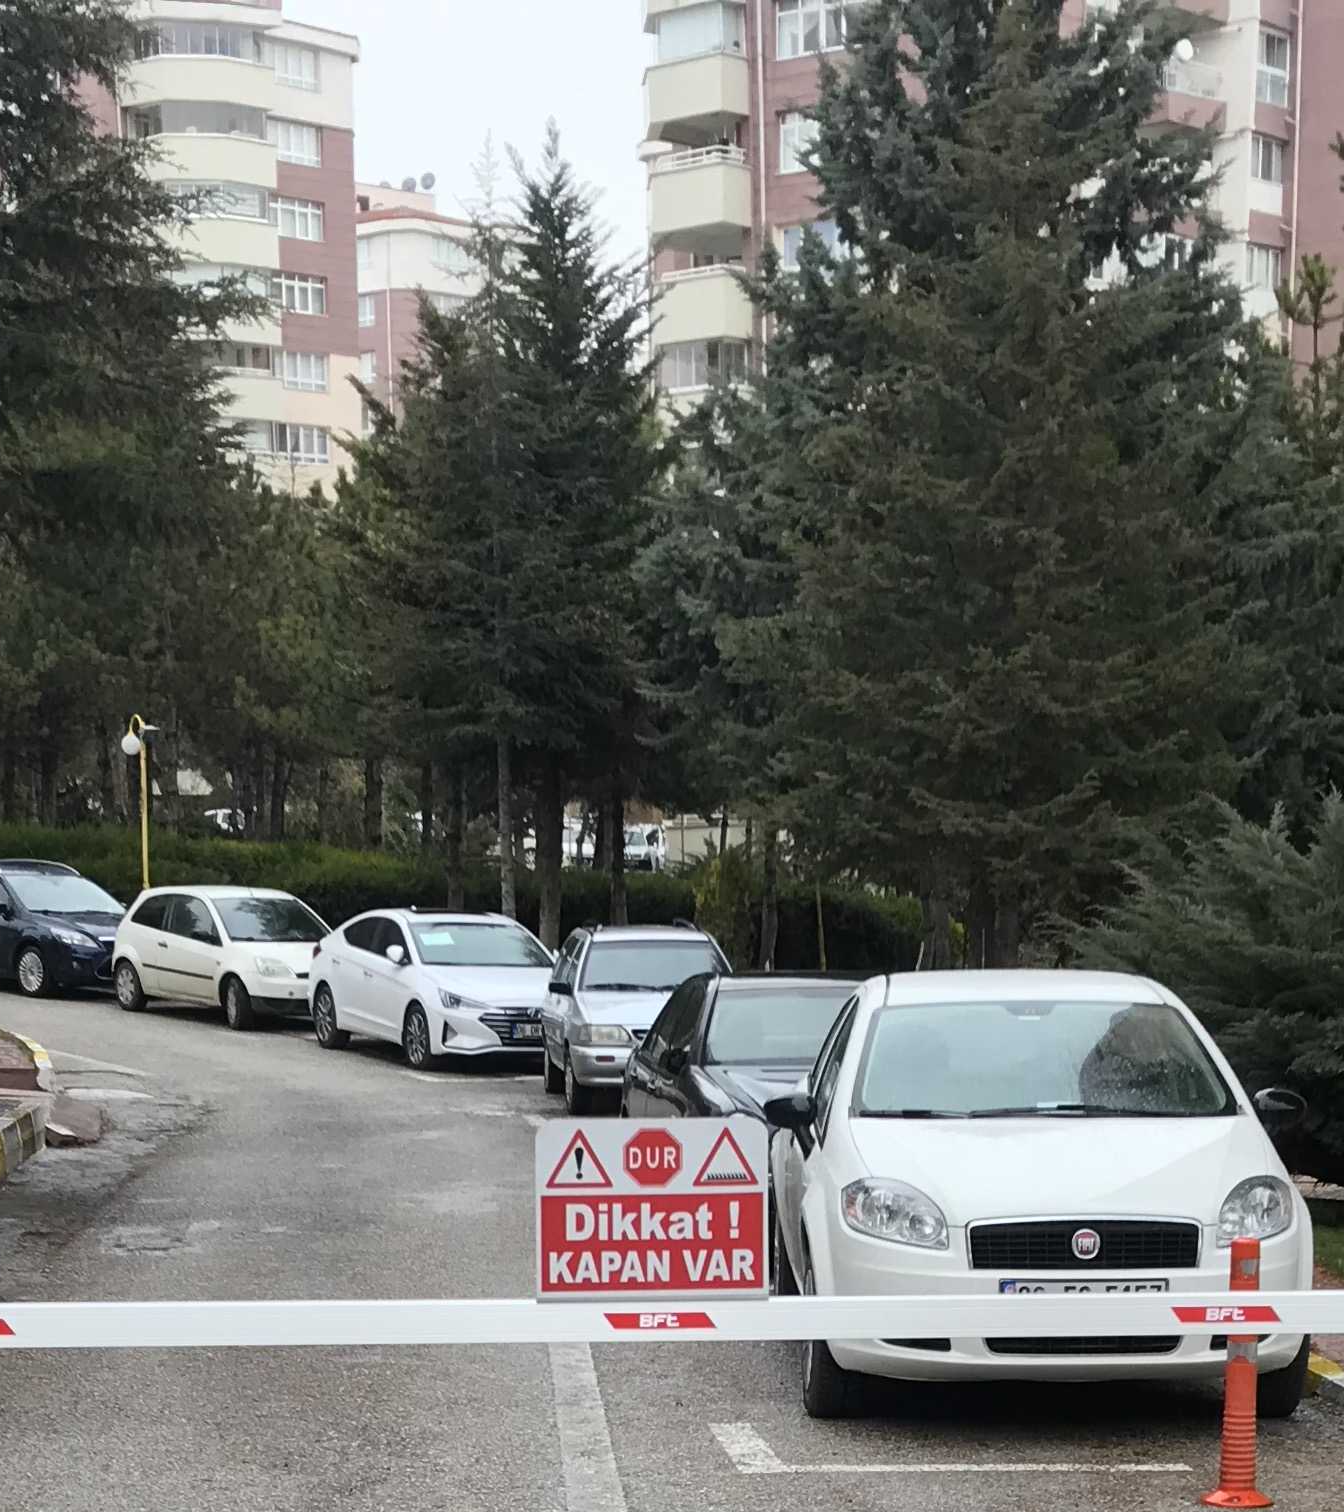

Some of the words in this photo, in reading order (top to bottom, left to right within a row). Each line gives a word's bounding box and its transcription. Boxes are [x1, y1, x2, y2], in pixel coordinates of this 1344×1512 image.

[629, 1146, 677, 1169] DUR
[565, 1202, 713, 1241] Dikkat
[729, 1201, 740, 1240] !
[549, 1250, 671, 1284] KAPAN
[682, 1248, 755, 1282] VAR
